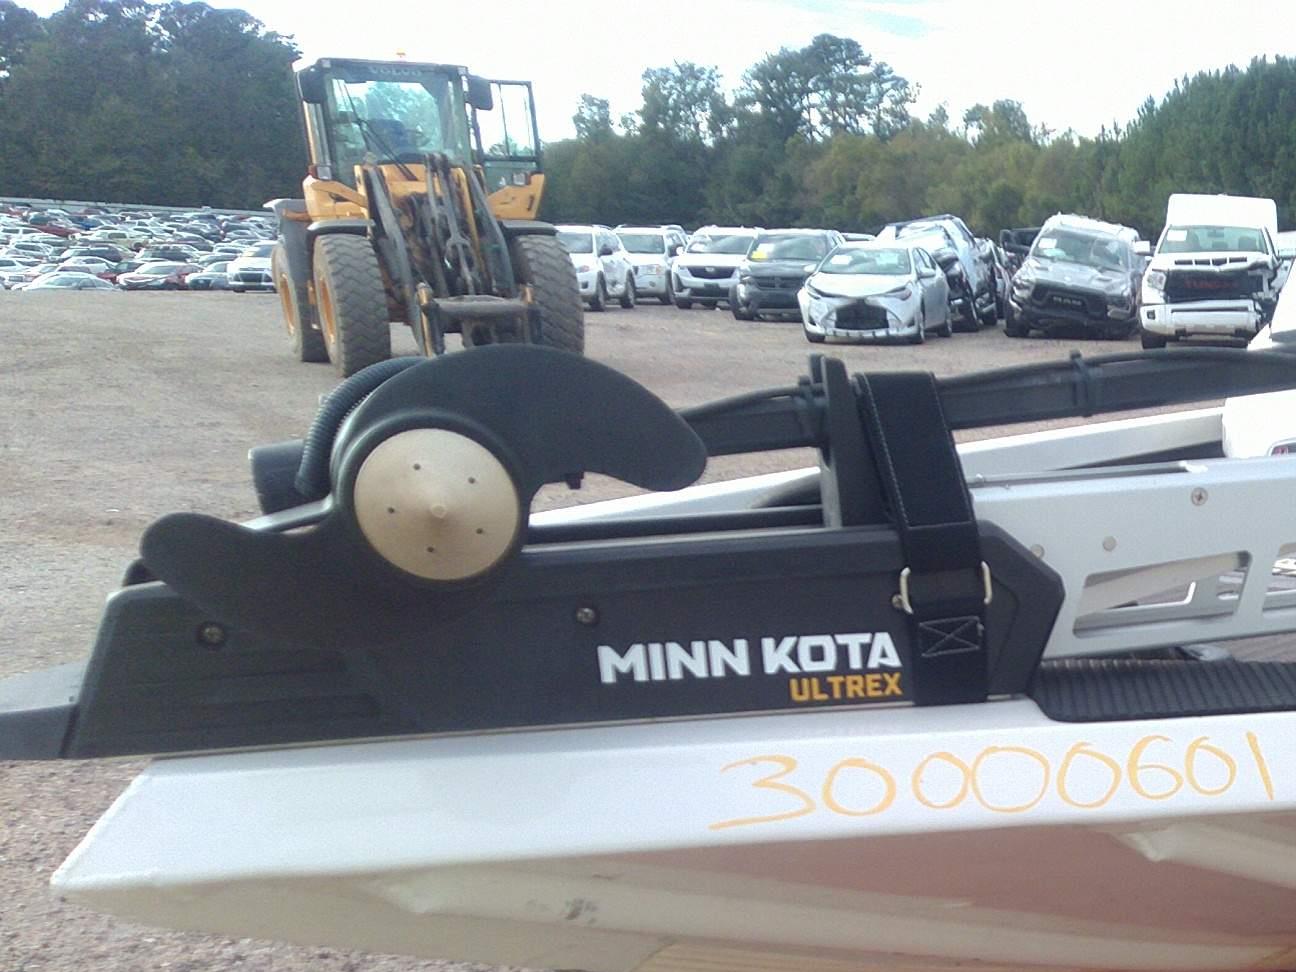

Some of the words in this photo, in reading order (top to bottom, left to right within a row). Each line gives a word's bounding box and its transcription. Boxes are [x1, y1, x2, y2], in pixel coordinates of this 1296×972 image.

[597, 638, 751, 684] MINN
[760, 631, 903, 675] KOTA
[789, 672, 903, 702] ULTREX
[708, 731, 1275, 830] 30000601
